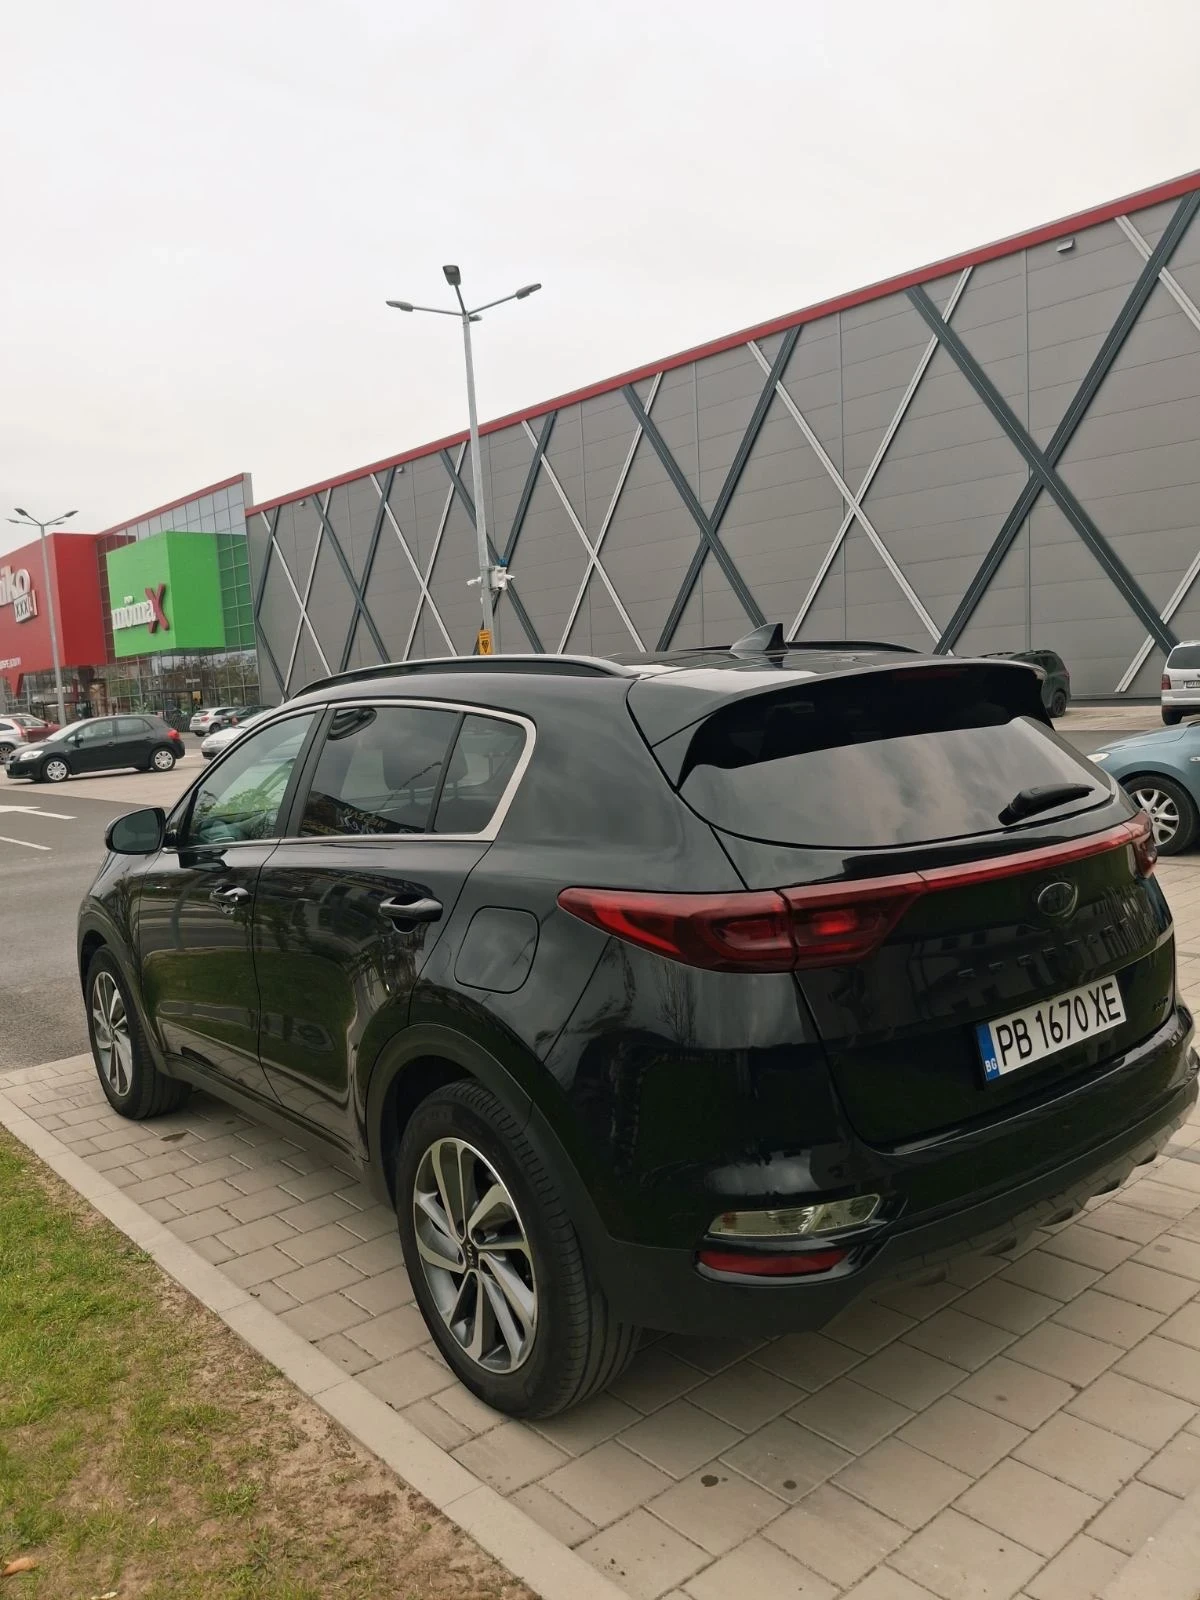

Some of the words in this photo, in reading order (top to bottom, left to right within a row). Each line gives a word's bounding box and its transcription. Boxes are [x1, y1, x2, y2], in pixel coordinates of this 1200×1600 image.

[995, 1018, 1032, 1066] PB
[1035, 996, 1089, 1049] 1670
[1088, 982, 1121, 1027] XE
[985, 1058, 998, 1073] BG
